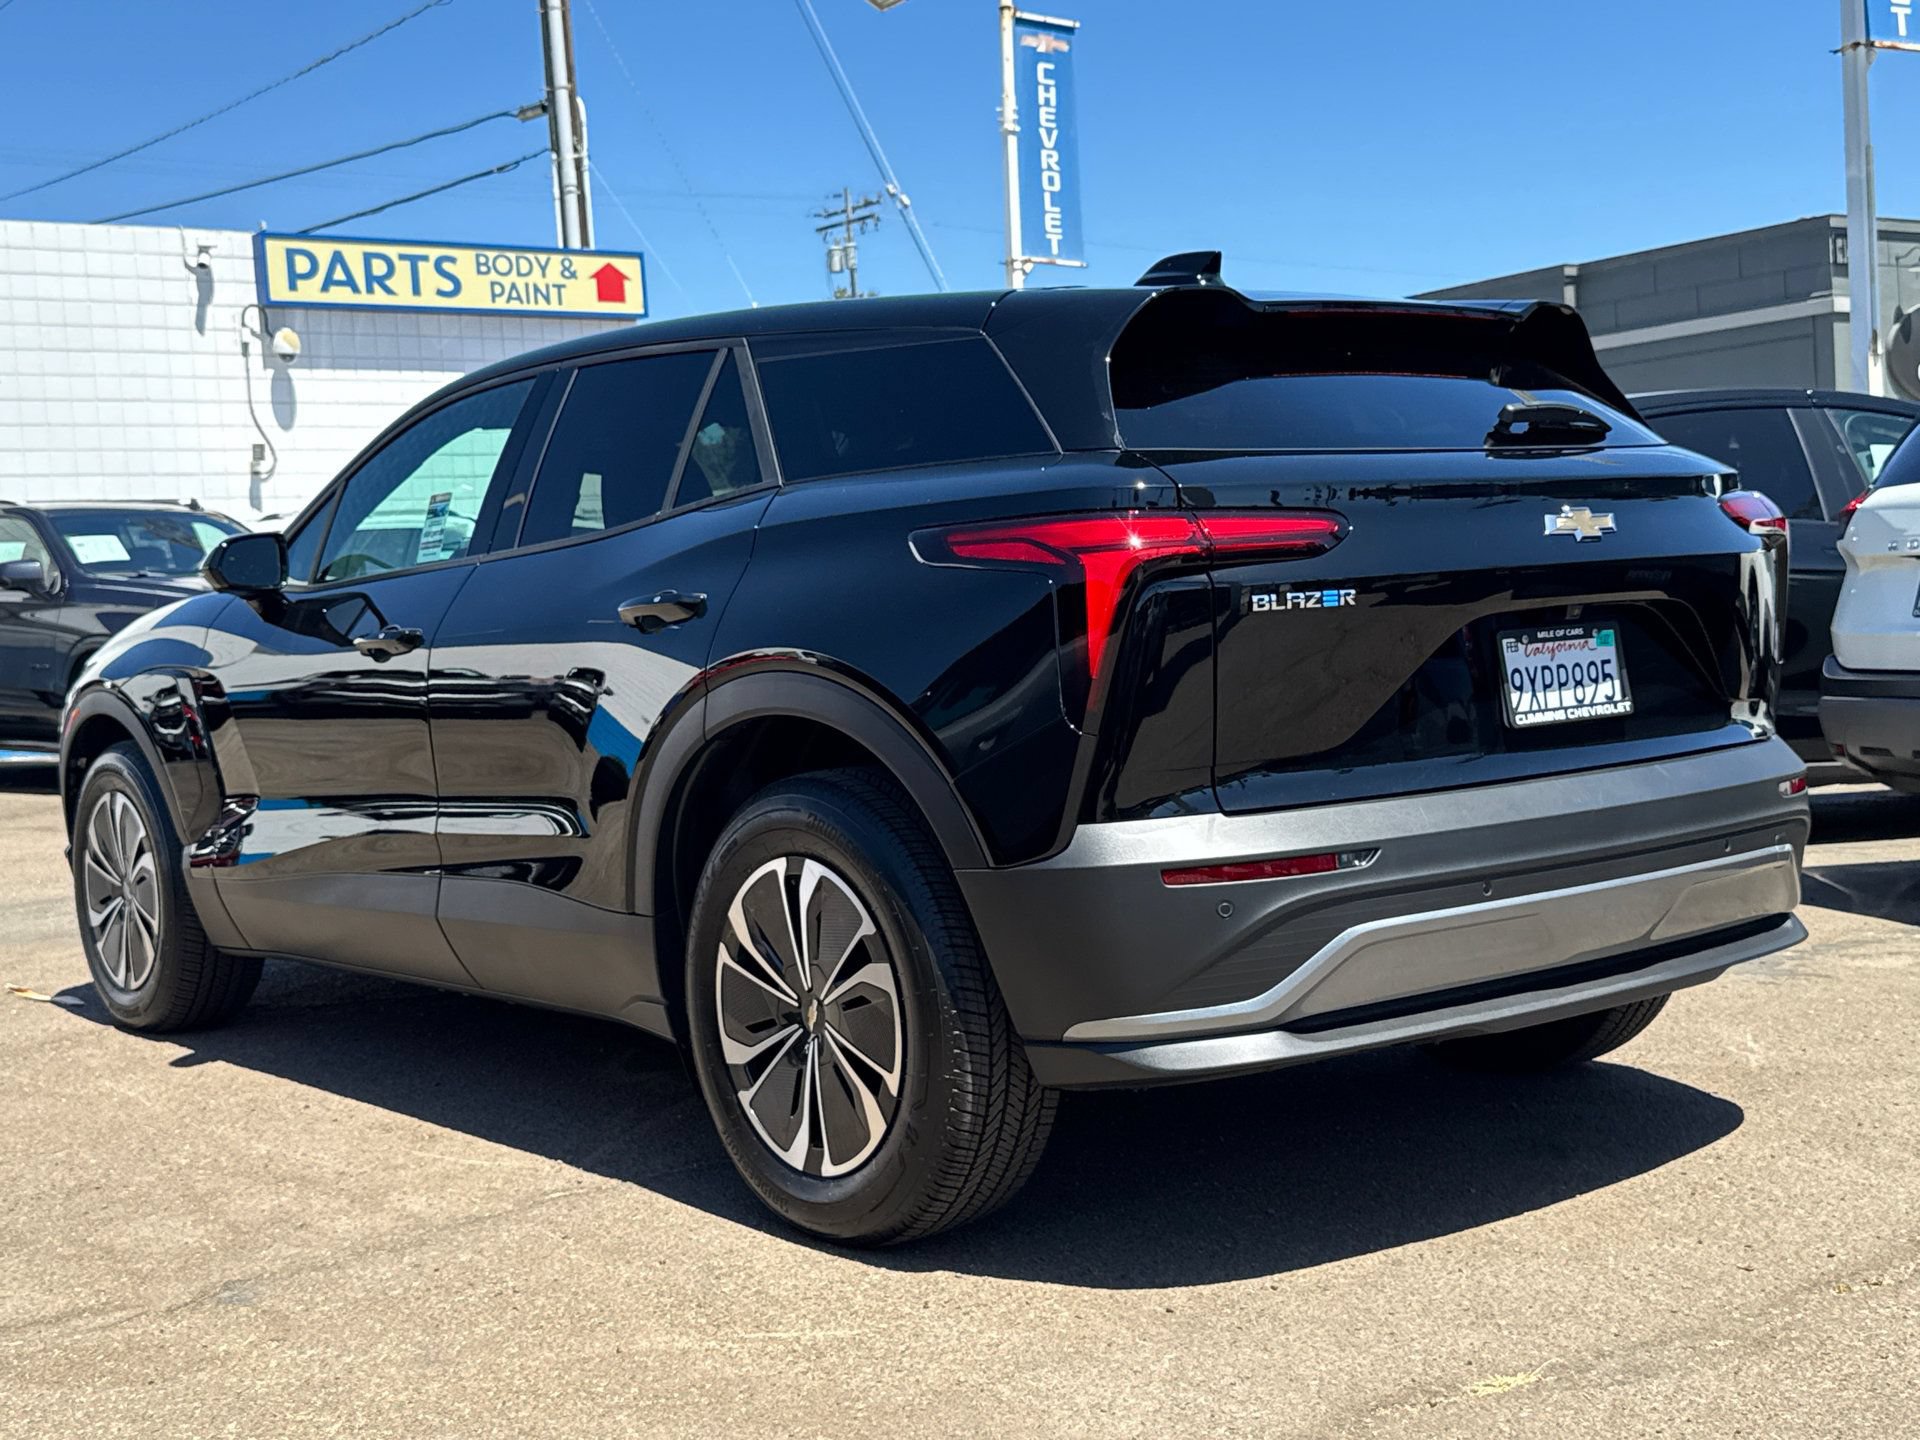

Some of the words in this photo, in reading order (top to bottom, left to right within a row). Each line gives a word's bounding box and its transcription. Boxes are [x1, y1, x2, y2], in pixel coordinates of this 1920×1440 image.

[1036, 61, 1064, 256] CHEVROLET
[284, 247, 463, 298] PARTS
[474, 252, 552, 279] BODY
[559, 257, 578, 280] &
[489, 281, 567, 306] PAINT
[1251, 589, 1357, 612] BLAZER
[1555, 629, 1565, 637] OF
[1566, 627, 1584, 636] CARS
[1524, 640, 1597, 661] California
[1510, 659, 1615, 712] 9XPP895
[1566, 701, 1632, 719] CHEVROLET
